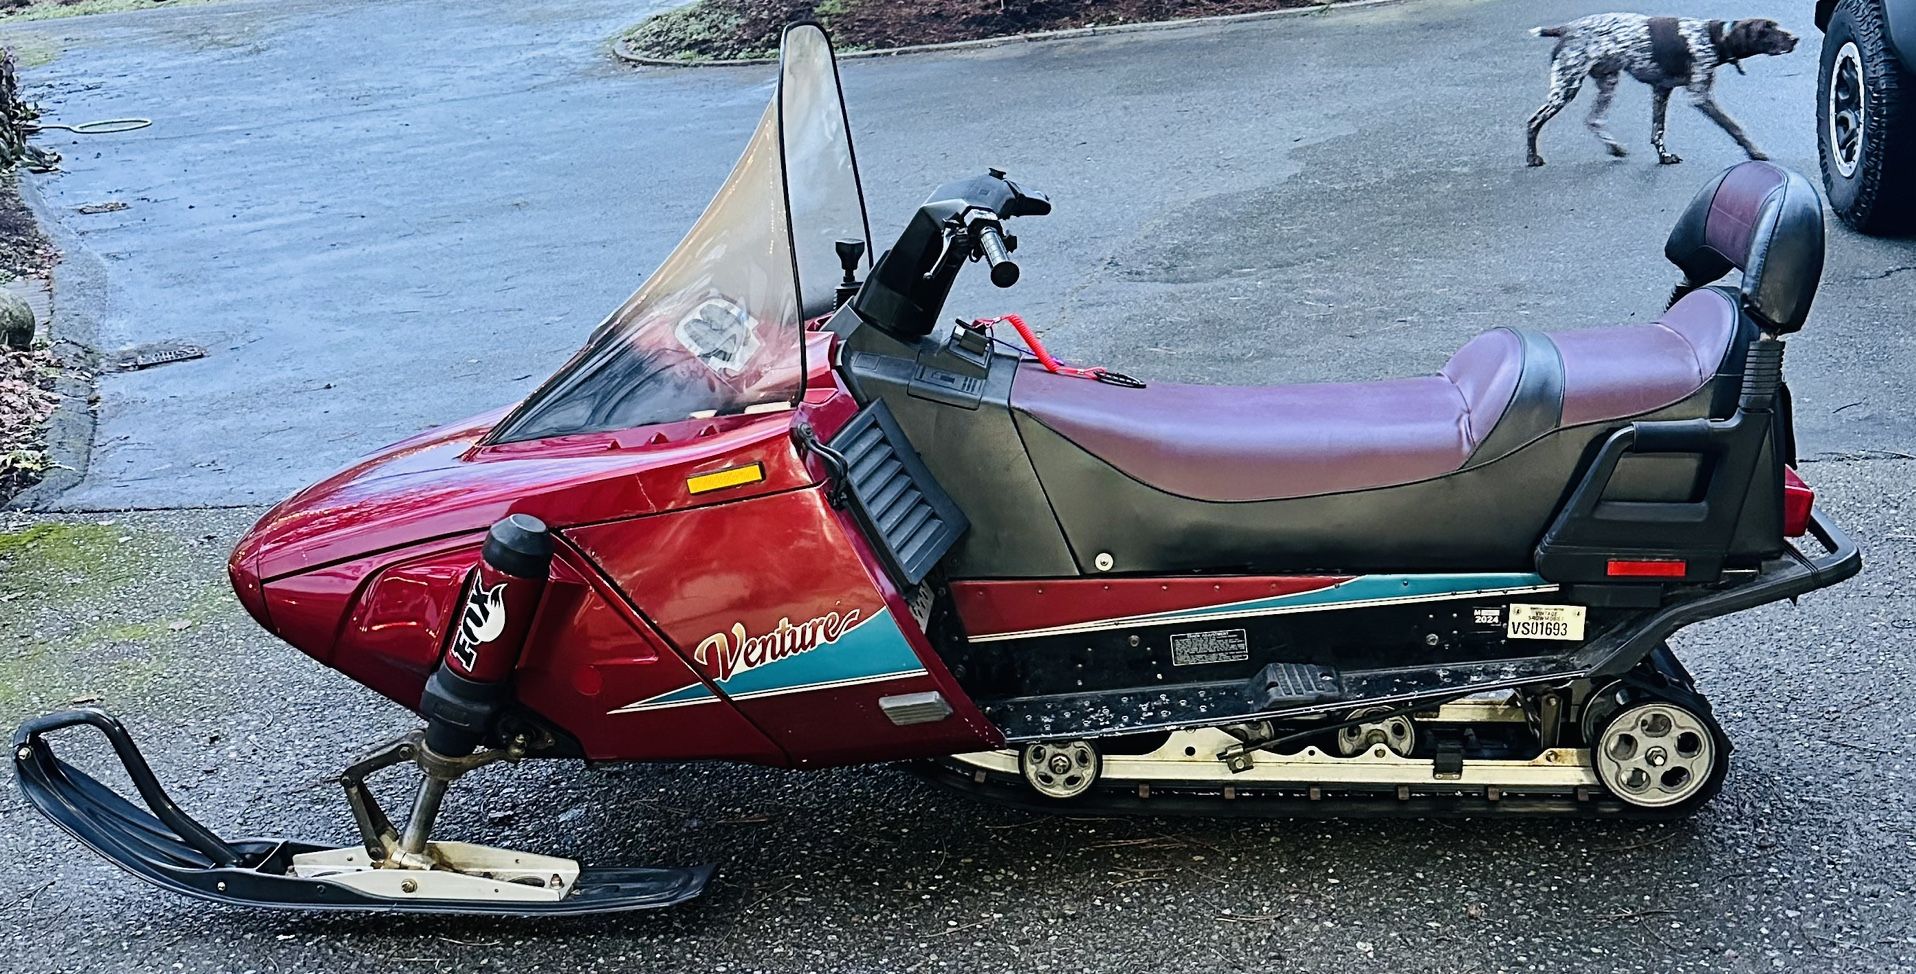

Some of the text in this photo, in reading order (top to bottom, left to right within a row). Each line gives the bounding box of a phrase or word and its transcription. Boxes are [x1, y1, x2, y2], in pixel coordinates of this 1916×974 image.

[451, 568, 495, 673] FOX
[694, 608, 861, 682] Venture
[1474, 615, 1499, 624] 2024
